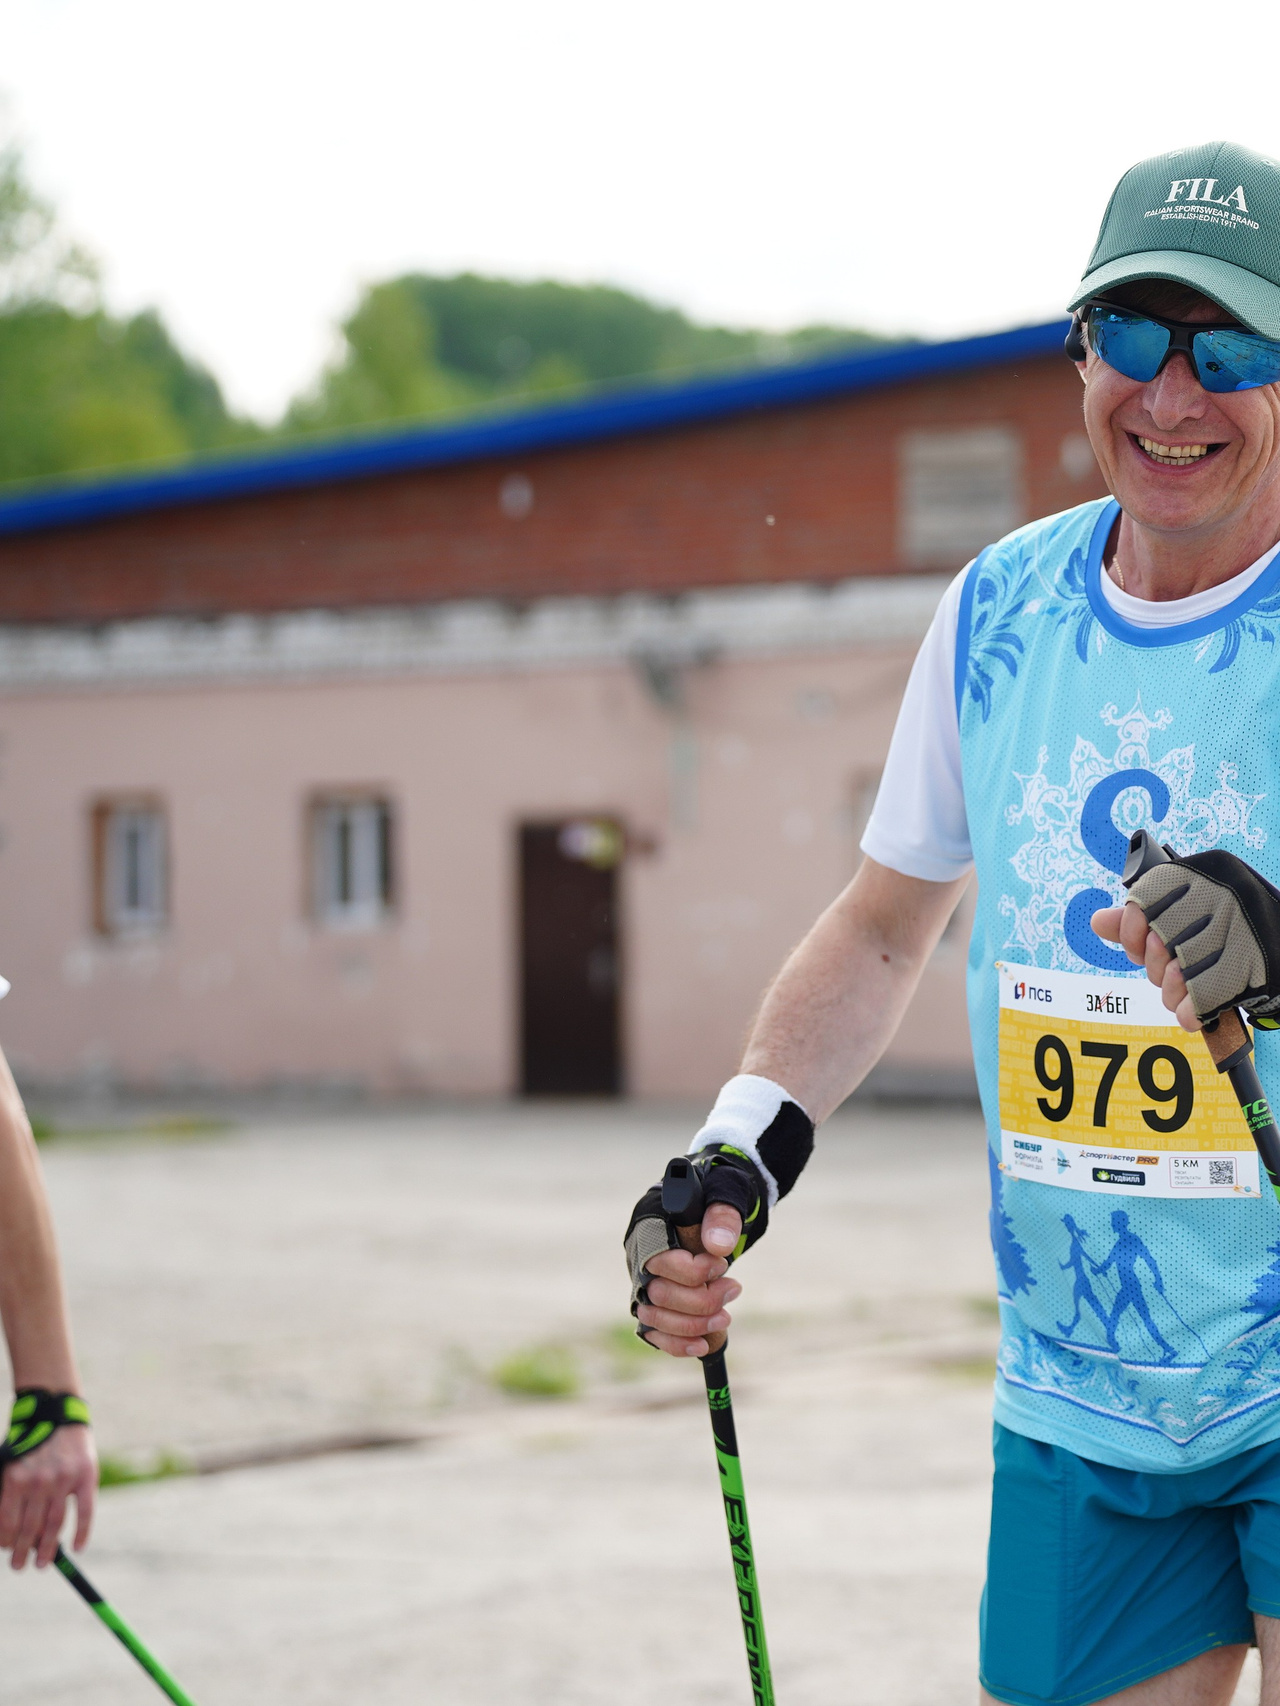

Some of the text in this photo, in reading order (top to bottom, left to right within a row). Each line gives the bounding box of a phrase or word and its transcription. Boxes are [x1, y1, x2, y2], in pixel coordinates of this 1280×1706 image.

[1164, 178, 1249, 213] FILA
[1144, 205, 1260, 230] ITALIAN SPORTSWEAR BRAND
[1161, 213, 1210, 222] ESTABLISHED
[1221, 218, 1237, 229] 1911
[1028, 986, 1053, 1003] ПСБ
[1033, 1034, 1195, 1134] 979
[1013, 1139, 1042, 1153] СИБУР
[1137, 1156, 1158, 1165] PRO
[1174, 1159, 1180, 1168] 5
